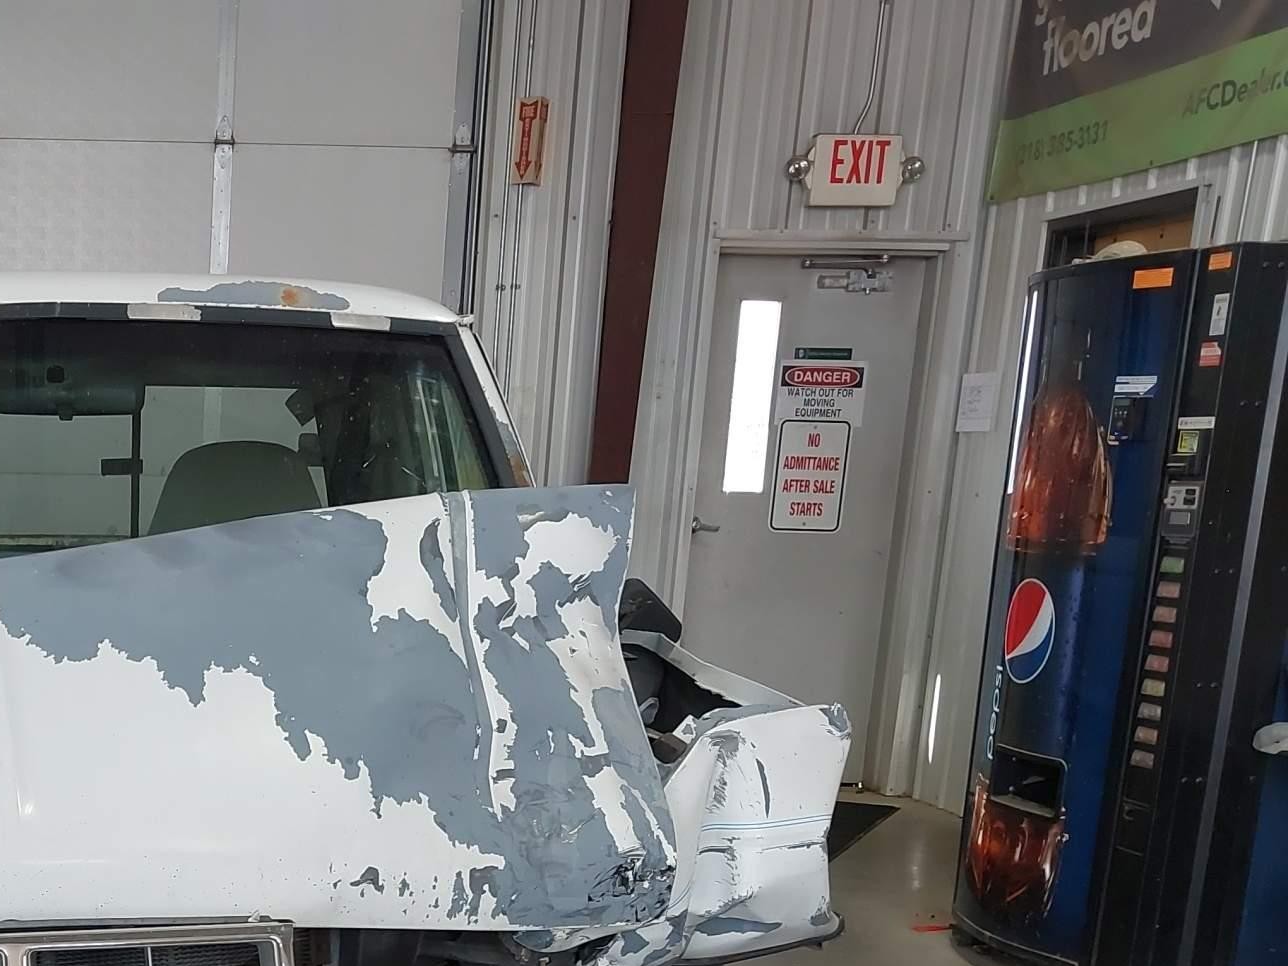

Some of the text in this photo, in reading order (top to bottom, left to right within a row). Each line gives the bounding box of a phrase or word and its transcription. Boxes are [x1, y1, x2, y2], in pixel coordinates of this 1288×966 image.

[1042, 0, 1157, 76] floored
[830, 139, 891, 184] EXIT
[793, 371, 851, 383] DANGER
[787, 388, 854, 398] WATCH OUT FOR
[803, 398, 835, 408] MOVING
[795, 408, 842, 418] EQUIPMENT
[808, 432, 821, 448] NO
[783, 455, 840, 471] ADMITTANCE
[782, 478, 835, 494] AFTER SALE
[789, 502, 823, 517] STARTS
[986, 665, 1003, 760] pepsi
